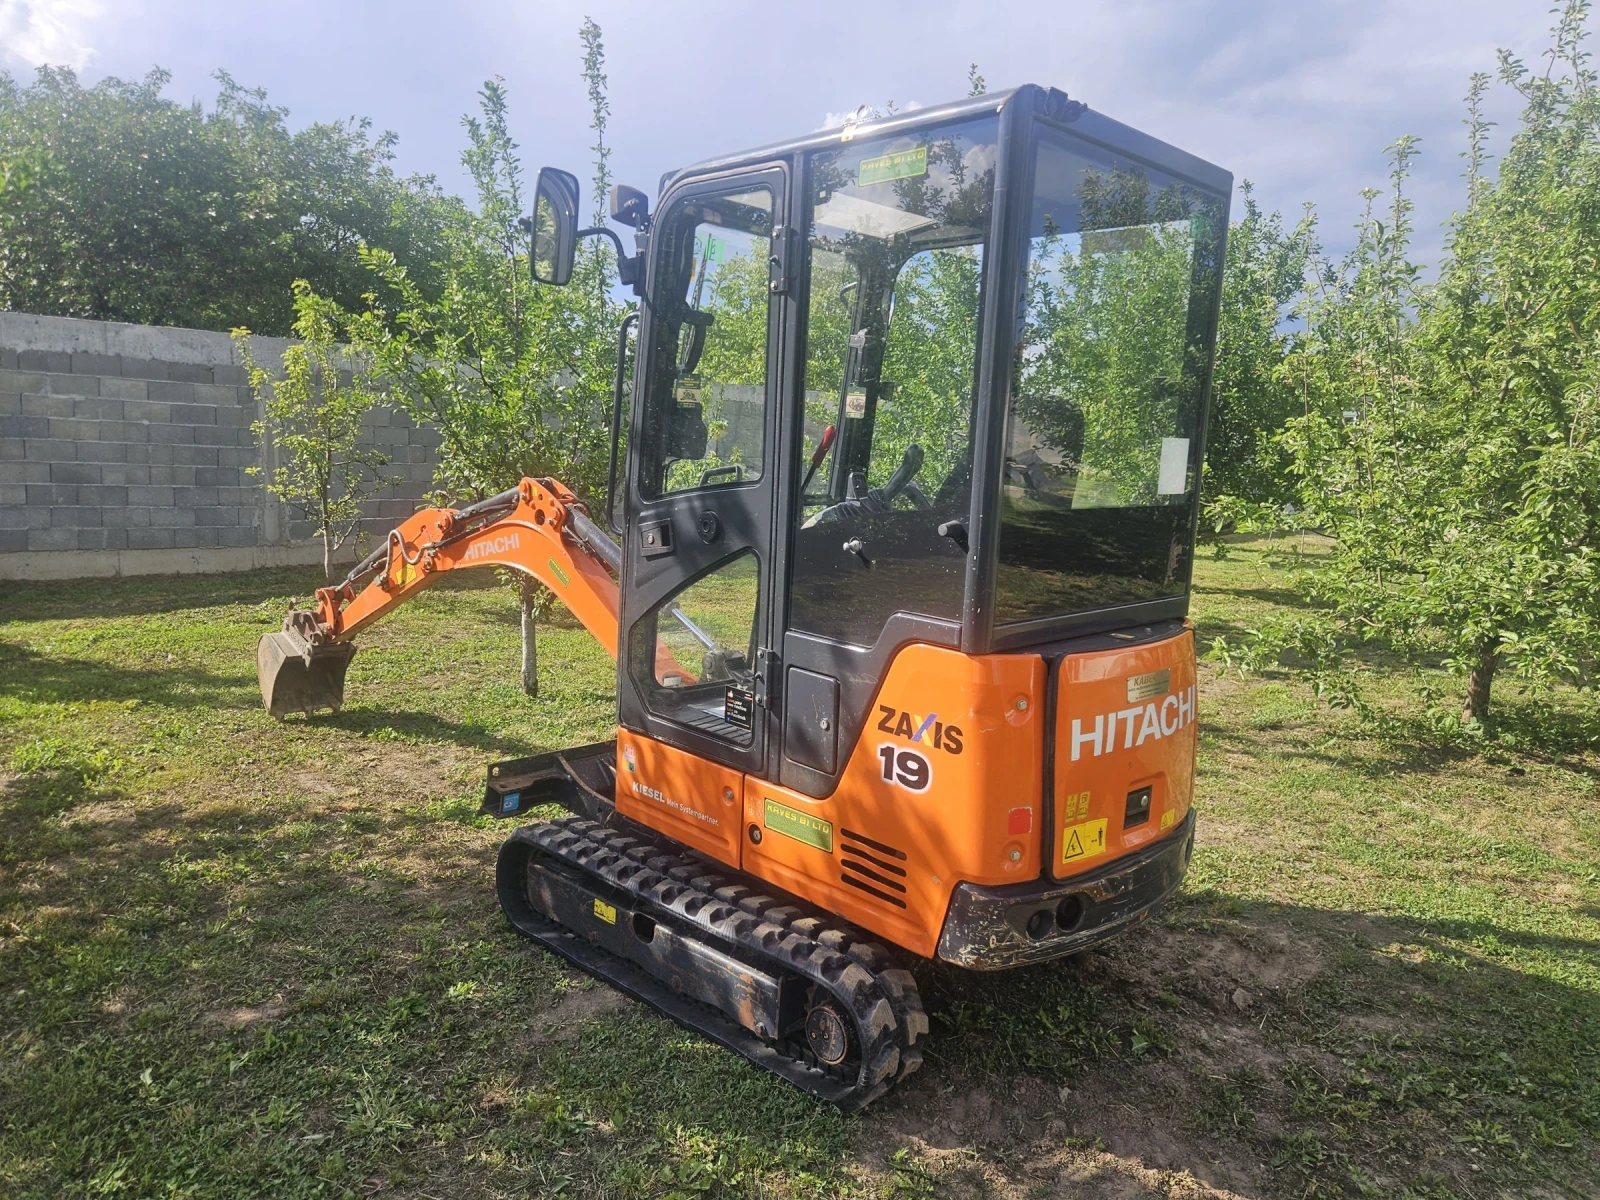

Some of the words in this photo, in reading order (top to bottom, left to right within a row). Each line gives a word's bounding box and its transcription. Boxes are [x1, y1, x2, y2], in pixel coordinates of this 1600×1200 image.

[465, 533, 520, 560] HITACHI
[877, 704, 964, 755] ZAXIS
[1071, 683, 1196, 762] HITACHI
[879, 745, 930, 791] 19
[632, 781, 665, 803] KIESEL
[666, 797, 679, 809] Mein
[679, 803, 719, 827] Systempartner.
[767, 803, 797, 821] KAVES
[799, 816, 810, 827] BI
[812, 820, 830, 834] LTD
